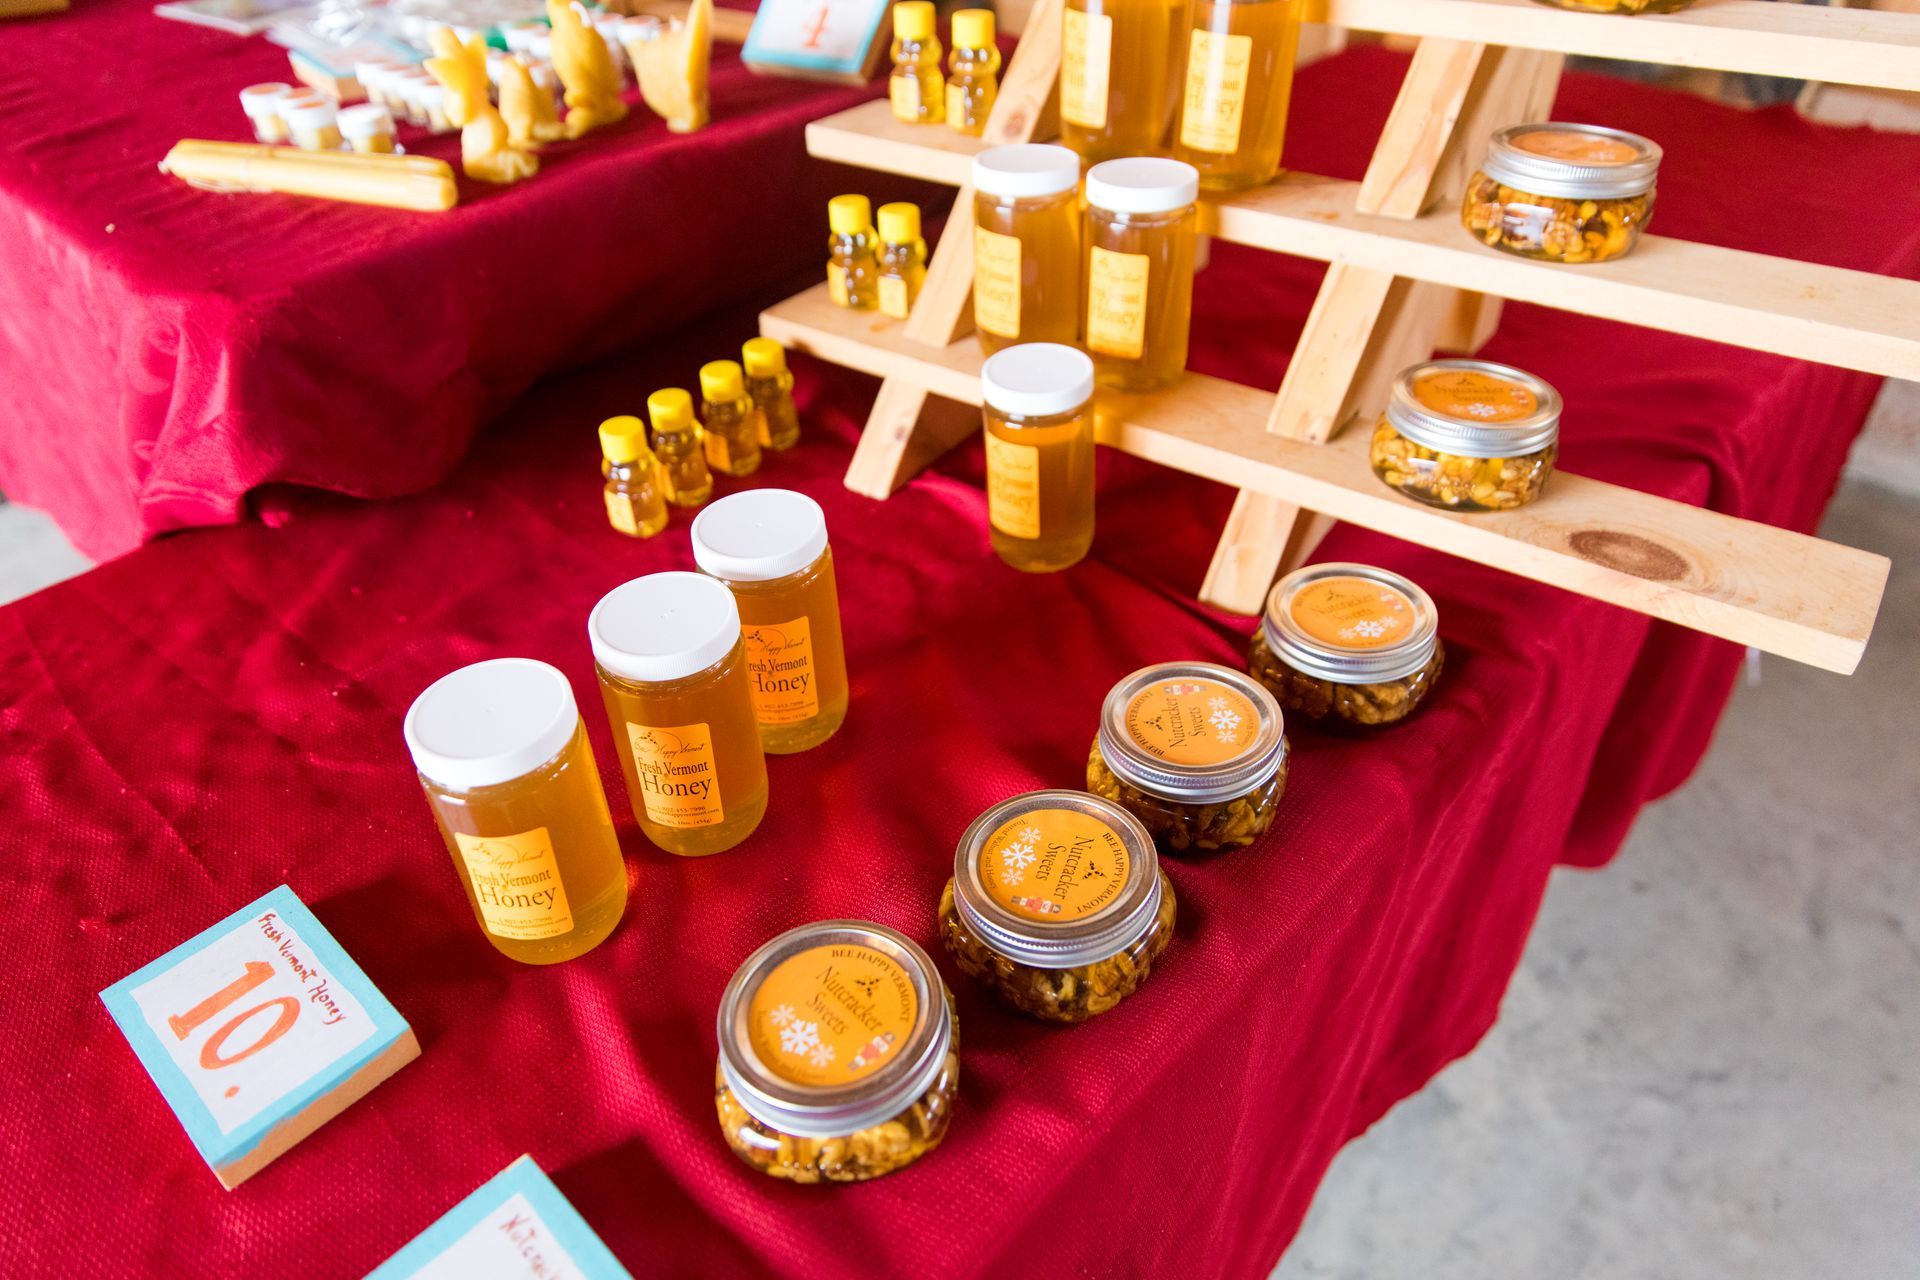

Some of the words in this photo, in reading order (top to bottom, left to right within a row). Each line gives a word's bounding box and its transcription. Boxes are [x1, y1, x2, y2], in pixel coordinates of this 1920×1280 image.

[749, 659, 767, 673] resh
[768, 655, 808, 673] Vermont
[1161, 697, 1188, 748] Nutcracker
[1188, 707, 1207, 737] Sweets
[638, 757, 662, 775] Fresh
[663, 761, 709, 776] Vermont
[641, 771, 712, 800] Honey
[1101, 832, 1116, 847] BEE
[1035, 842, 1067, 881] Sweets
[1053, 835, 1095, 900] Nutcracker
[1112, 845, 1125, 876] HAPPY
[474, 868, 500, 887] Fresh
[500, 868, 552, 889] Vermont
[478, 882, 557, 910] Honey
[1076, 875, 1121, 915] VERMONT
[257, 913, 282, 944] Fresh
[307, 979, 349, 1026] Honey
[831, 948, 856, 959] BEE
[855, 950, 894, 974] HAPPY
[888, 969, 911, 1023] VERMONT
[806, 991, 850, 1036] Sweets
[815, 965, 886, 1032] Nutcracker
